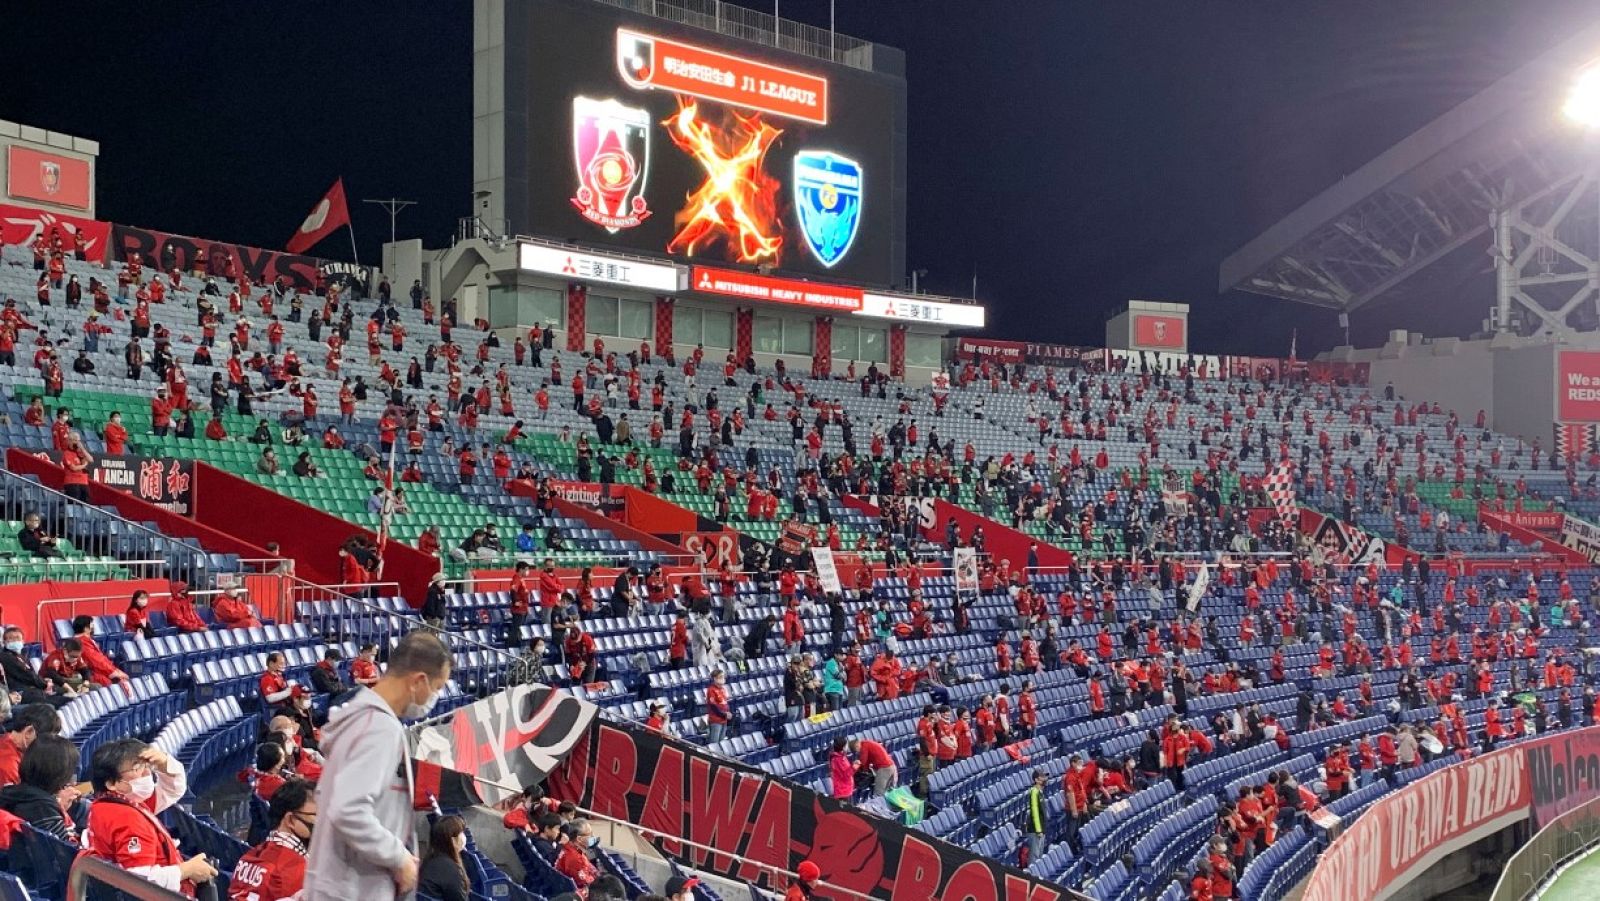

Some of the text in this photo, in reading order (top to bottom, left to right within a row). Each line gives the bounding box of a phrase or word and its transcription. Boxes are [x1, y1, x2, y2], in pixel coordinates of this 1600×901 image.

[663, 56, 816, 106] 明治安田生命 J1 LEAGUE
[579, 258, 630, 282] 三菱重工
[714, 280, 859, 308] MITSUBISHI HEAVY INDUSTRIES
[899, 301, 944, 320] 三菱重工
[1568, 373, 1591, 386] We
[140, 458, 189, 500] 浦和
[548, 725, 792, 893] URAWA
[1388, 768, 1459, 870] URAWA
[1463, 747, 1524, 827] REDS
[233, 860, 267, 887] POLUS
